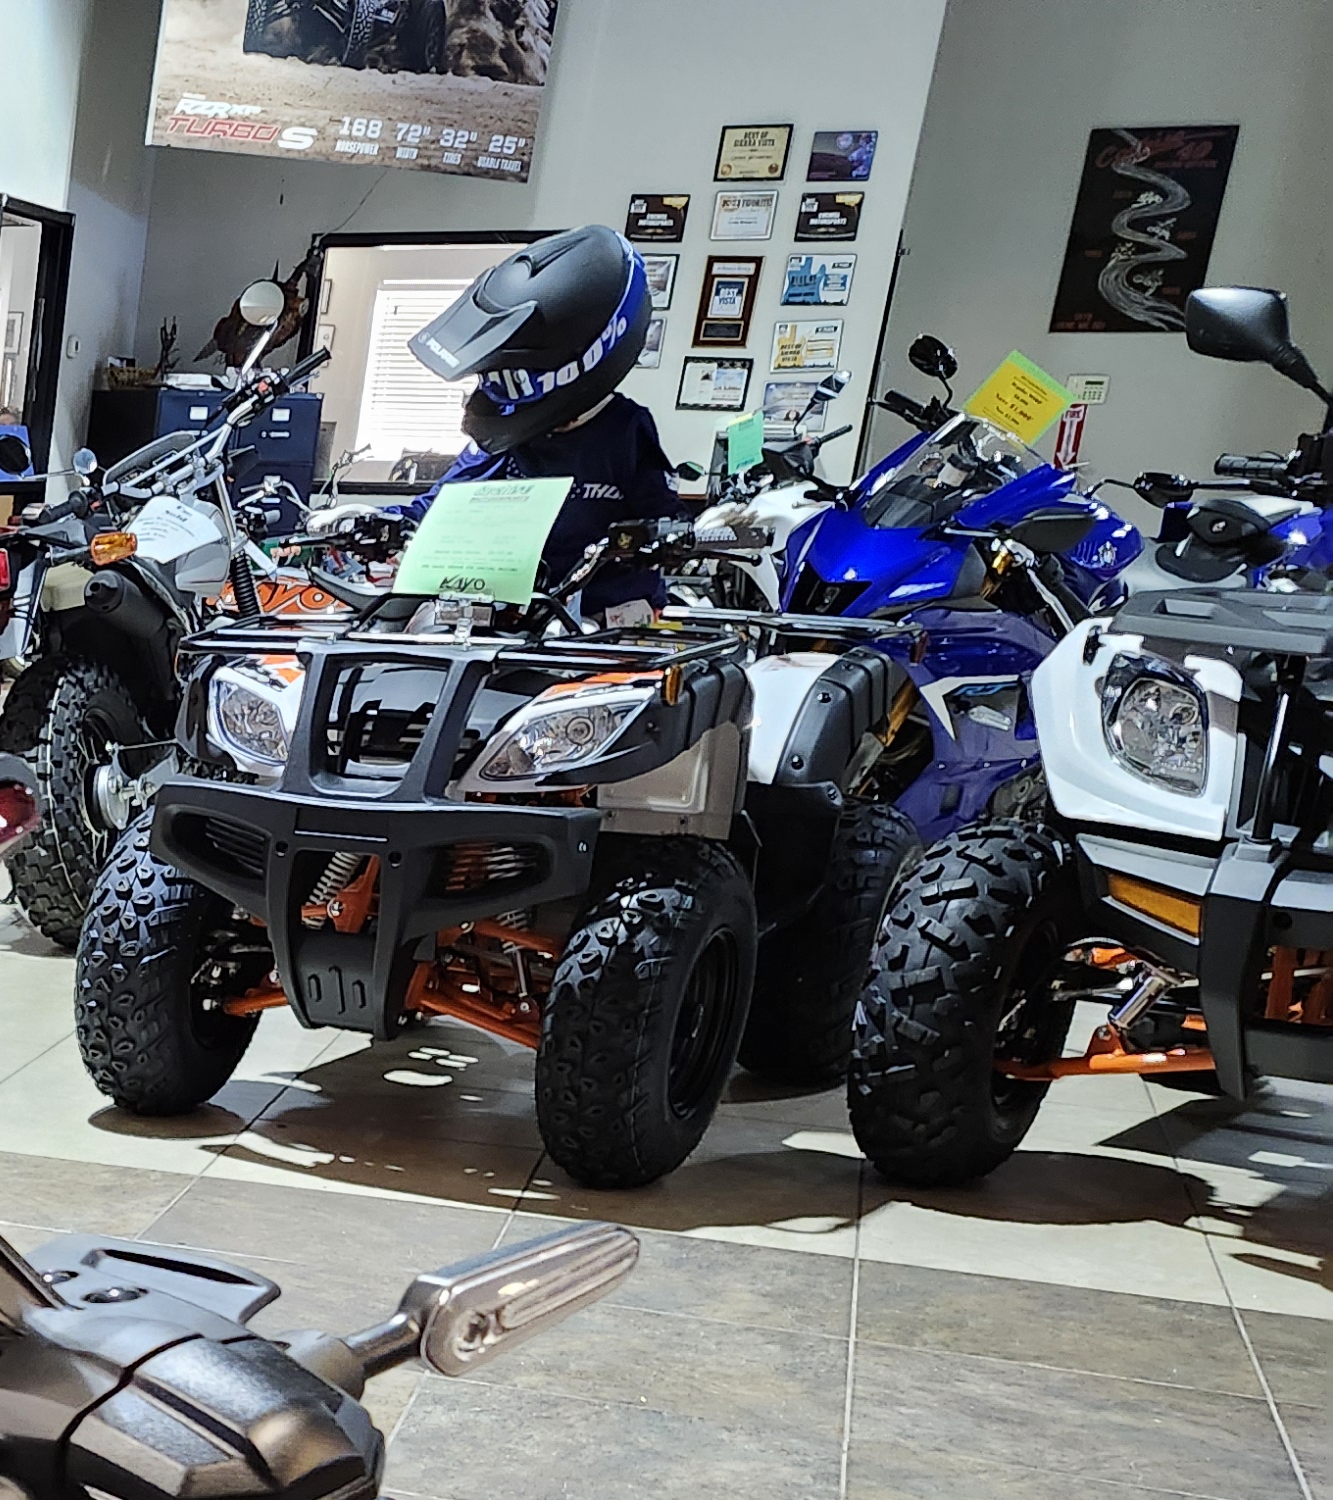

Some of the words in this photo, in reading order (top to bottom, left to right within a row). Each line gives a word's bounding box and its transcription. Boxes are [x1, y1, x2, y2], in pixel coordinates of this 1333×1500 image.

[166, 115, 281, 143] TURBO
[277, 126, 318, 150] S
[339, 116, 383, 139] 168
[396, 122, 431, 144] 72"
[439, 128, 478, 149] 32"
[488, 134, 526, 155] 25"
